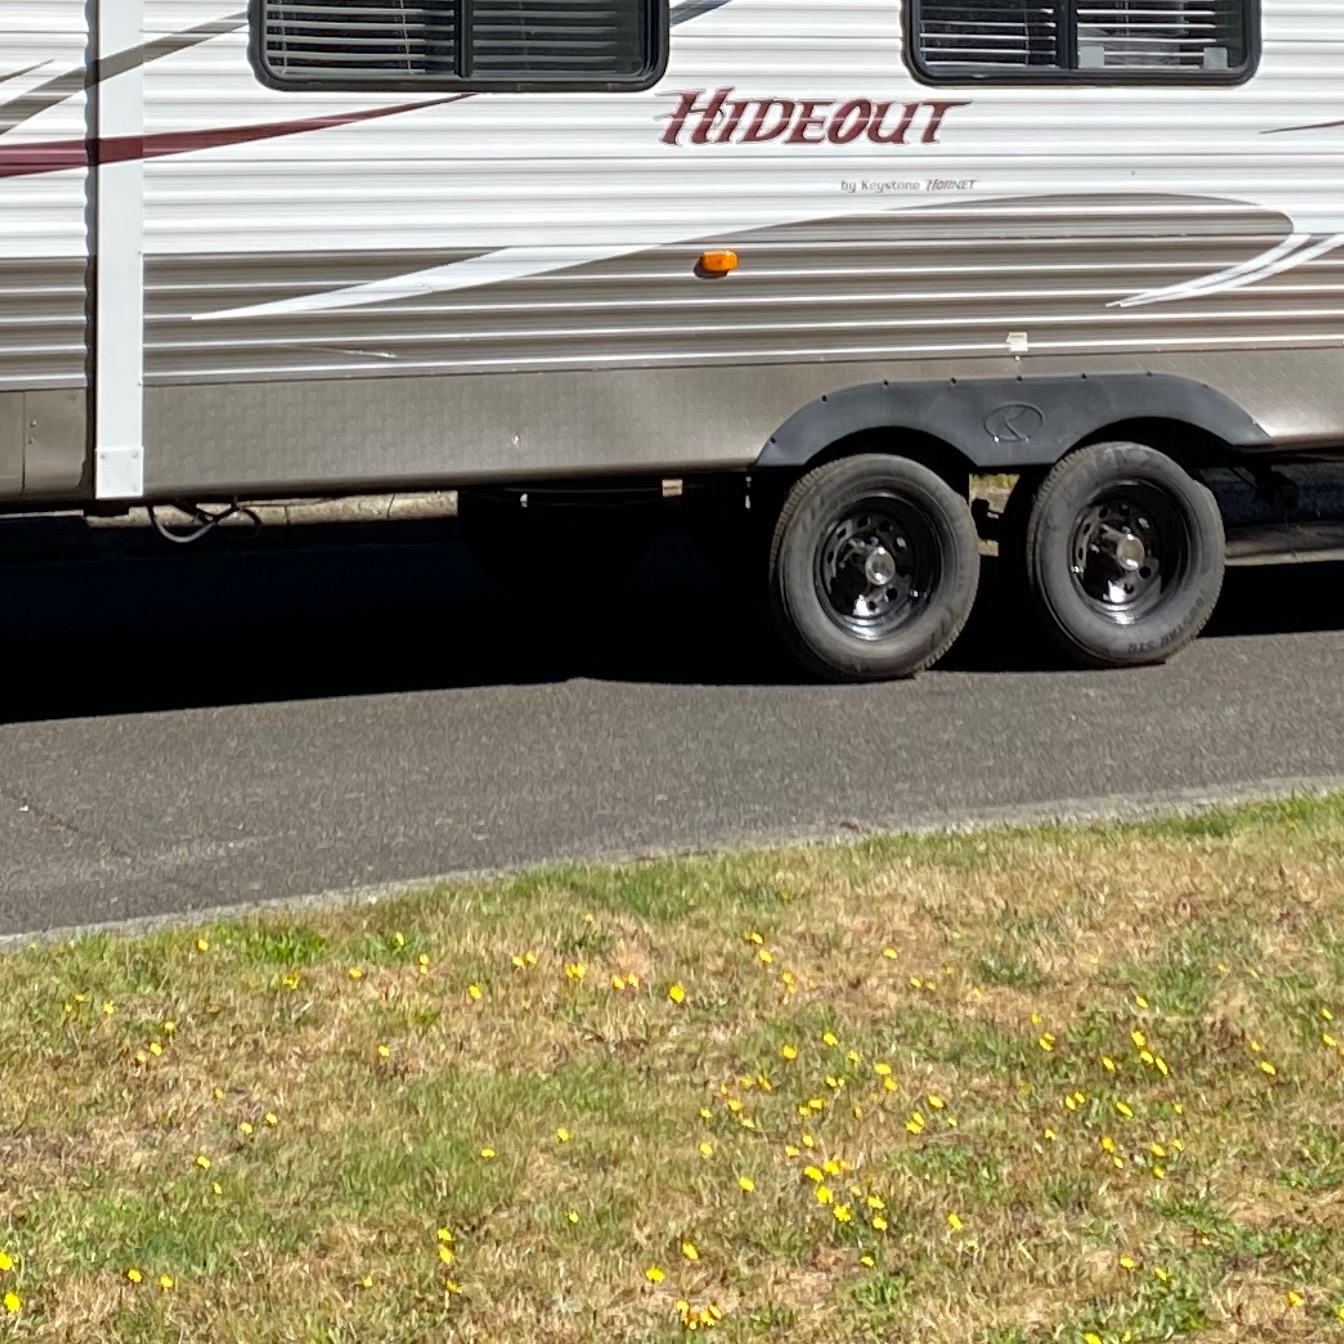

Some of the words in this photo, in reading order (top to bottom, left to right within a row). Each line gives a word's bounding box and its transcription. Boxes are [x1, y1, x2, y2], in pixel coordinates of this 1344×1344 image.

[653, 85, 973, 147] HIDEOUT
[841, 180, 857, 194] by
[861, 179, 921, 194] Keystone
[925, 178, 978, 192] HORNET
